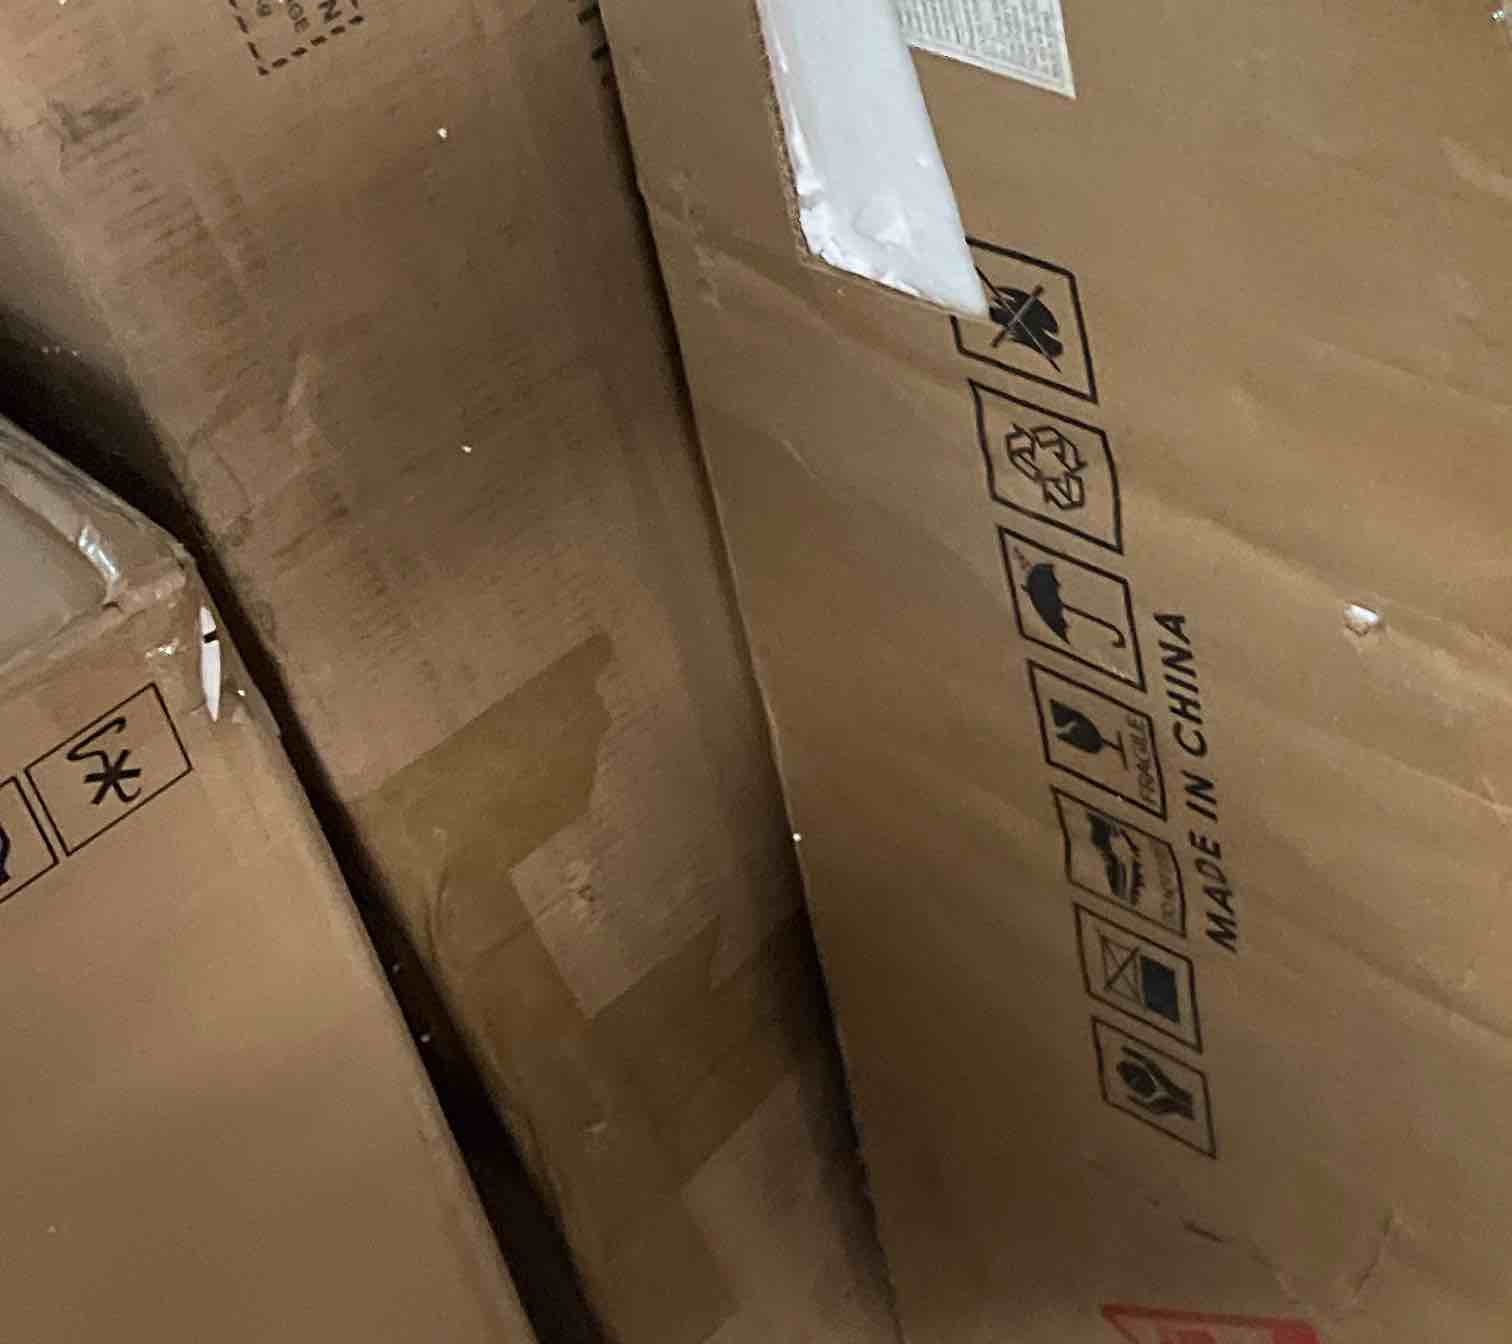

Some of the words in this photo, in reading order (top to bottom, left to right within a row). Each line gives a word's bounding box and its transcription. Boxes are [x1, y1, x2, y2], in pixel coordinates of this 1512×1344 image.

[1153, 612, 1209, 758] CHINA
[1180, 769, 1218, 824] IN
[1188, 827, 1239, 955] MADE
